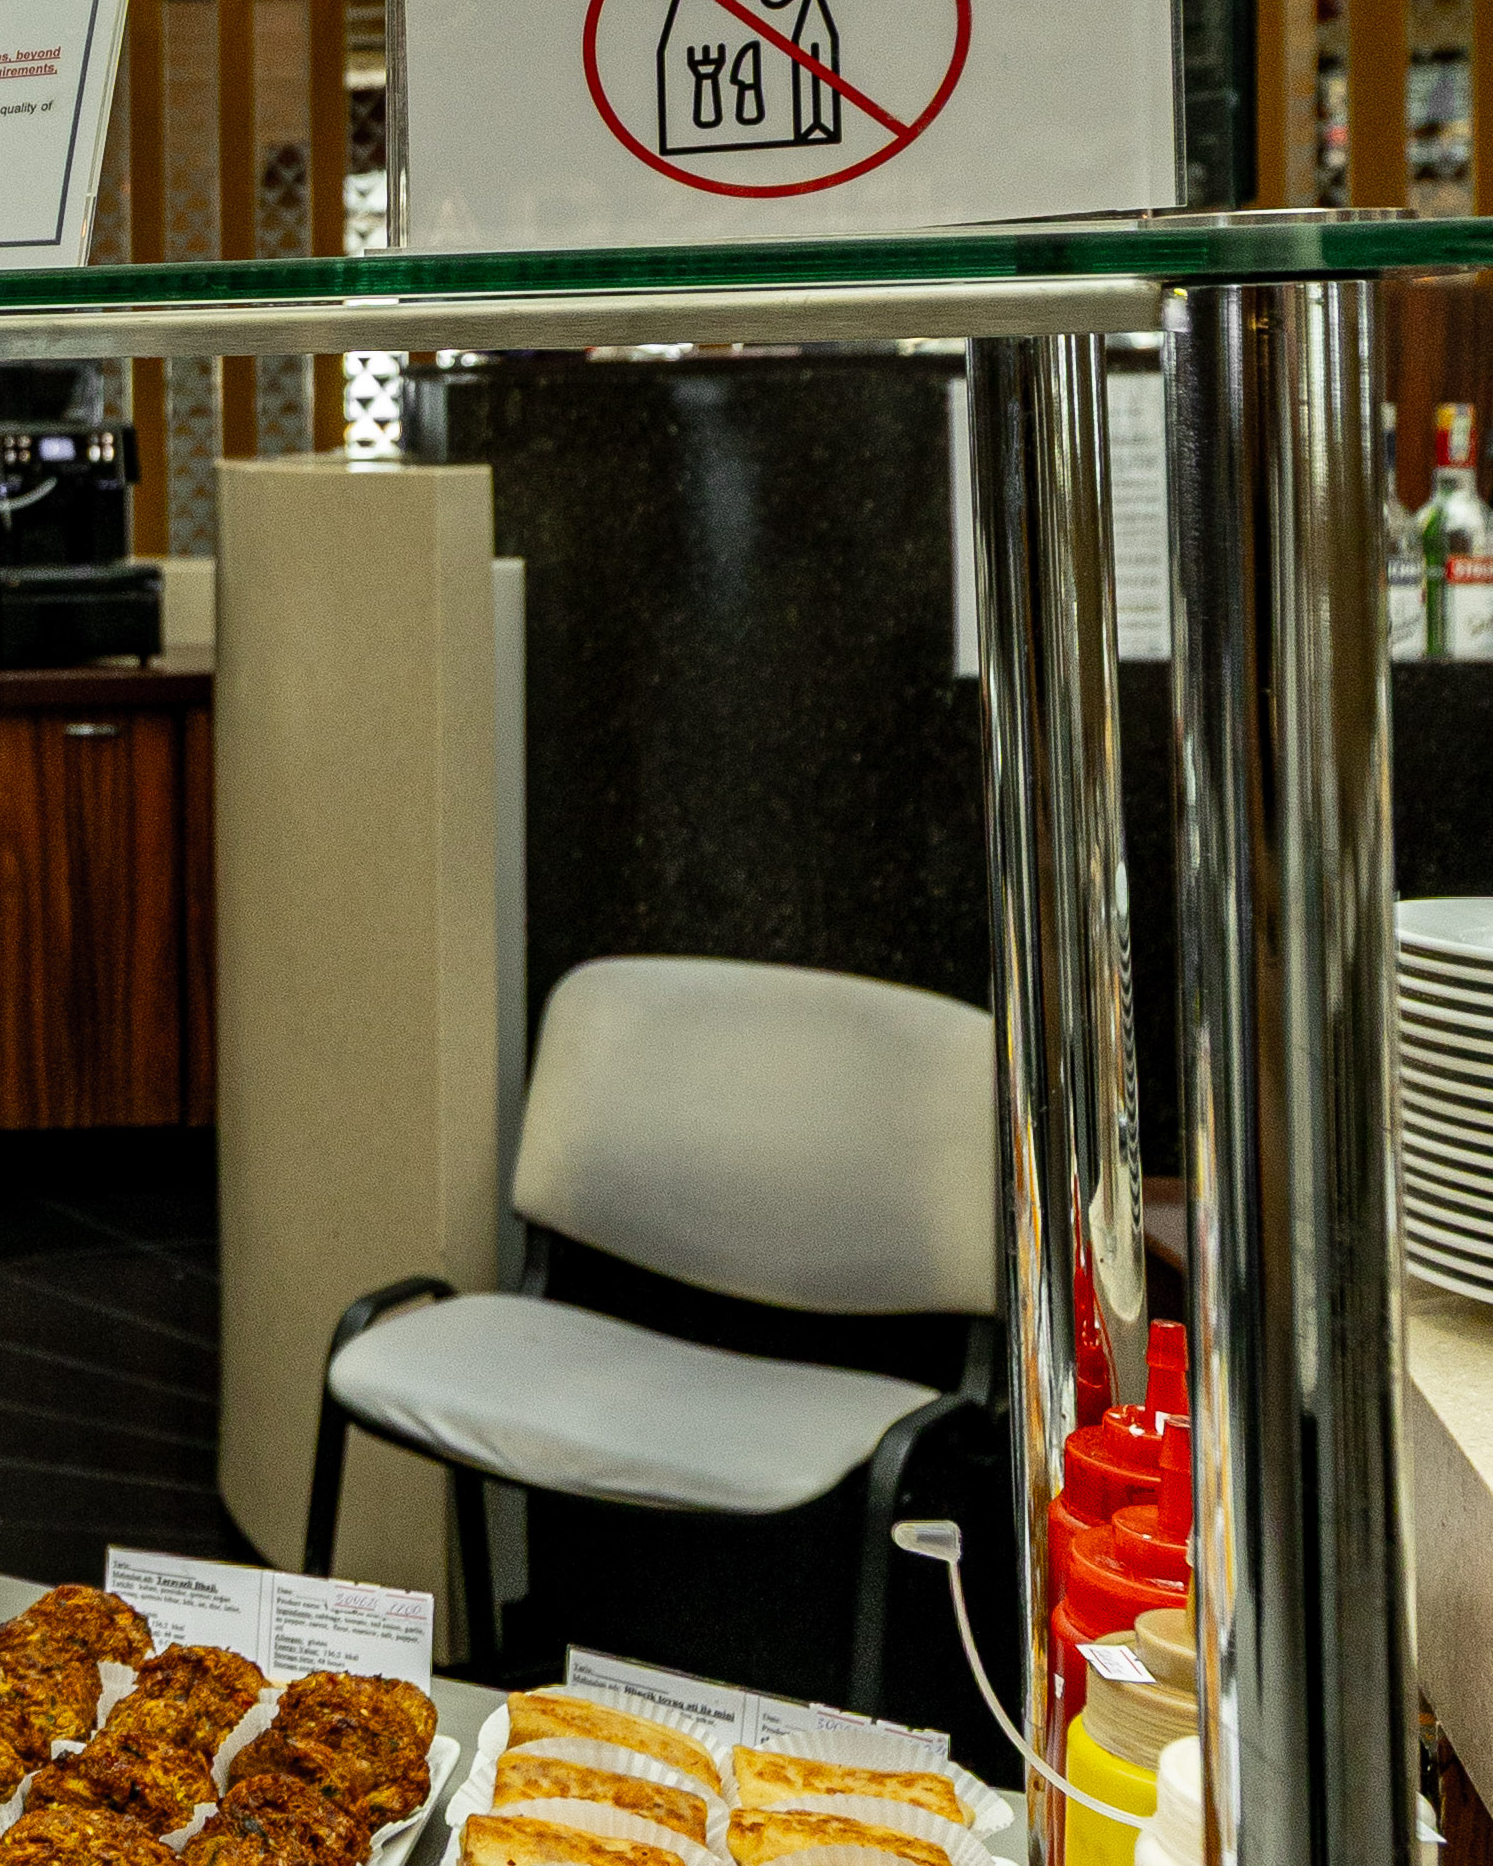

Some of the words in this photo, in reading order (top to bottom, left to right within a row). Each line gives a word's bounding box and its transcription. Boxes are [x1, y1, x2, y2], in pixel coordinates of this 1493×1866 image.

[13, 45, 61, 62] beyond
[0, 101, 37, 117] quality
[40, 99, 54, 111] of
